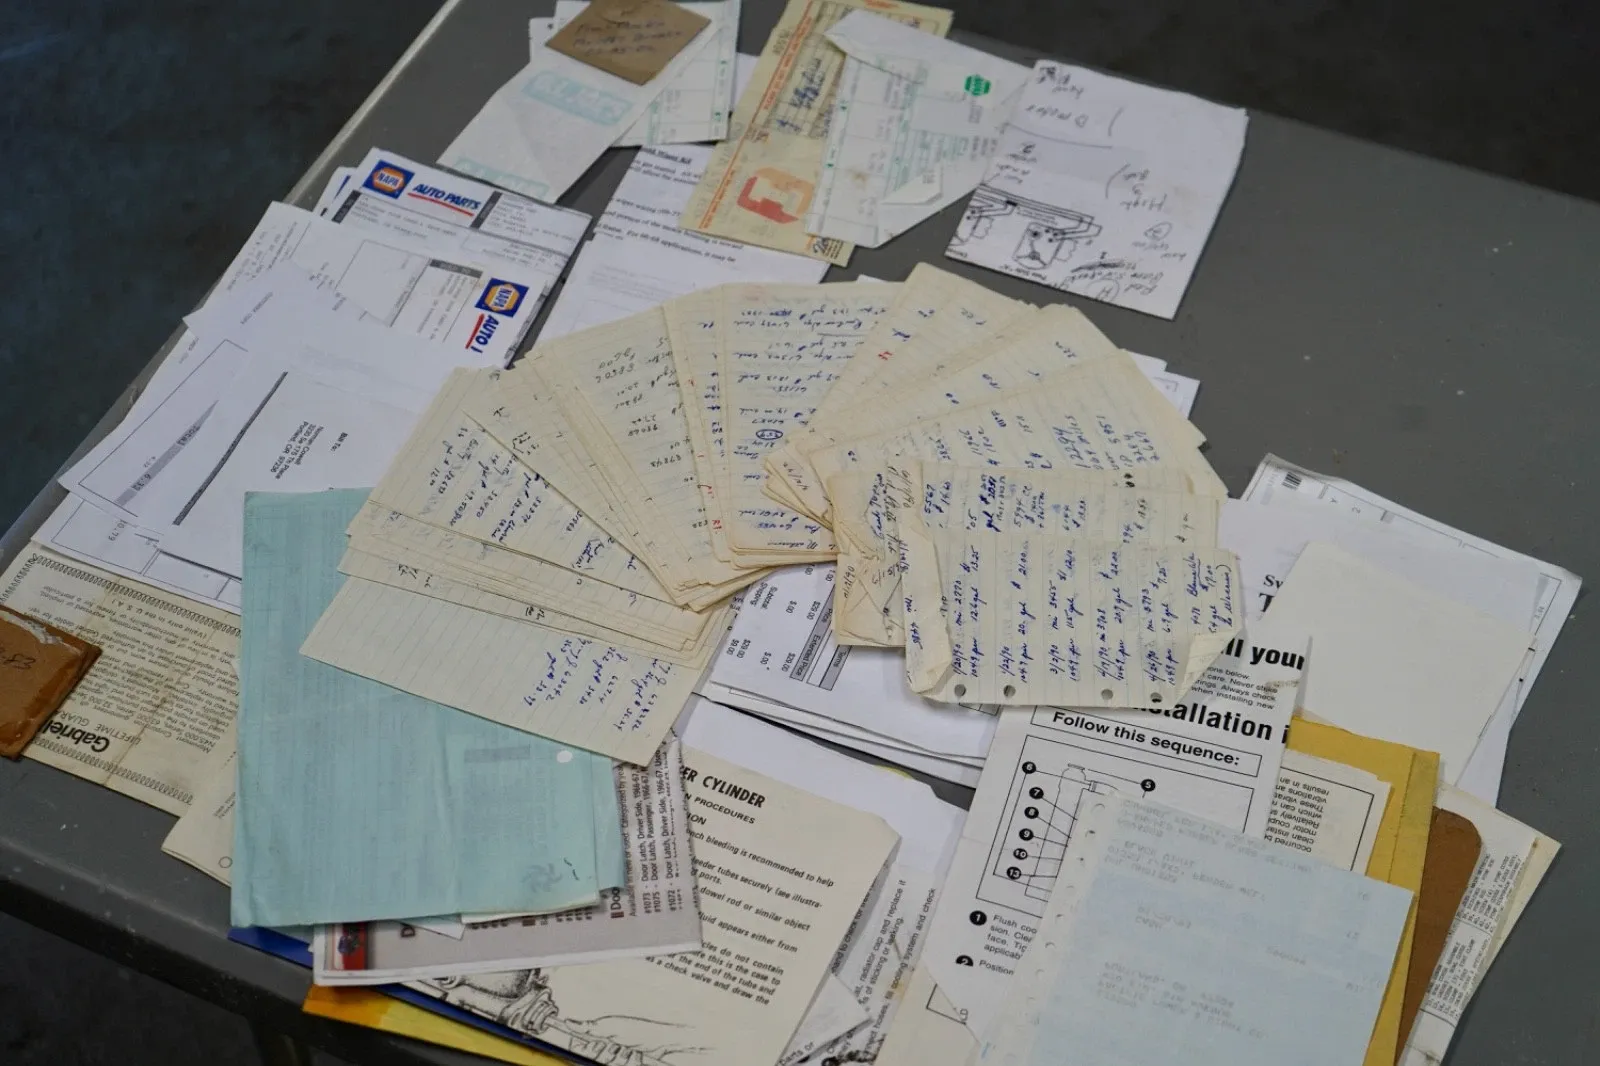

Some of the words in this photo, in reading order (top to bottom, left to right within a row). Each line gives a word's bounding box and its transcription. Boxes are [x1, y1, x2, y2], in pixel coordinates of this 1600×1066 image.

[377, 171, 400, 187] NAPA
[412, 183, 446, 202] AUTO
[445, 190, 481, 211] PARTS
[494, 285, 513, 309] NAPA
[475, 315, 500, 345] AUTO
[803, 634, 821, 661] Extended
[796, 662, 807, 676] Price
[94, 724, 141, 745] LIFETIME
[1053, 711, 1109, 734] Follow
[1115, 726, 1145, 742] this
[1152, 736, 1240, 766] sequence:
[703, 776, 765, 808] CYLINDER
[1288, 788, 1326, 803] vibrations
[1303, 784, 1329, 795] results
[634, 800, 643, 817] Side,
[658, 797, 667, 814] Side,
[694, 797, 755, 824] PROCEDURES
[1298, 809, 1322, 818] which
[1300, 800, 1323, 812] These
[646, 802, 654, 838] Passenger,
[1280, 811, 1320, 829] Relatively
[1292, 834, 1314, 844] clean
[1293, 825, 1316, 836] motor
[639, 842, 647, 862] Latch,
[648, 840, 656, 861] Latch,
[663, 838, 671, 857] Latch,
[1274, 838, 1311, 852] occurred
[706, 836, 739, 854] bleeding
[739, 848, 748, 857] is
[748, 854, 804, 878] recommended
[816, 876, 834, 887] help
[699, 872, 721, 884] ports.
[718, 867, 739, 880] tubes
[740, 876, 772, 893] securely
[775, 888, 790, 898] (see
[792, 894, 822, 908] illustra-
[643, 893, 652, 914] #1073
[653, 892, 661, 912] #1075
[668, 890, 676, 911] #1072
[700, 887, 725, 900] dowel
[726, 898, 742, 906] rod
[755, 909, 782, 921] similar
[784, 919, 810, 930] object
[900, 933, 918, 960] system
[916, 915, 926, 930] and
[923, 888, 936, 912] check
[990, 926, 1009, 936] sion.
[993, 915, 1017, 927] Flush
[718, 922, 749, 936] appears
[751, 934, 775, 944] either
[778, 940, 797, 952] from
[860, 952, 875, 981] radiator
[873, 937, 884, 951] cap
[880, 919, 890, 934] and
[887, 888, 903, 917] replace
[988, 933, 1008, 945] face.
[735, 954, 750, 963] not
[753, 961, 784, 975] contain
[870, 956, 888, 984] sticking
[979, 960, 1014, 975] Position
[664, 963, 687, 974] check
[692, 973, 712, 983] valve
[732, 988, 752, 998] draw
[739, 978, 757, 989] tube
[752, 972, 768, 981] case
